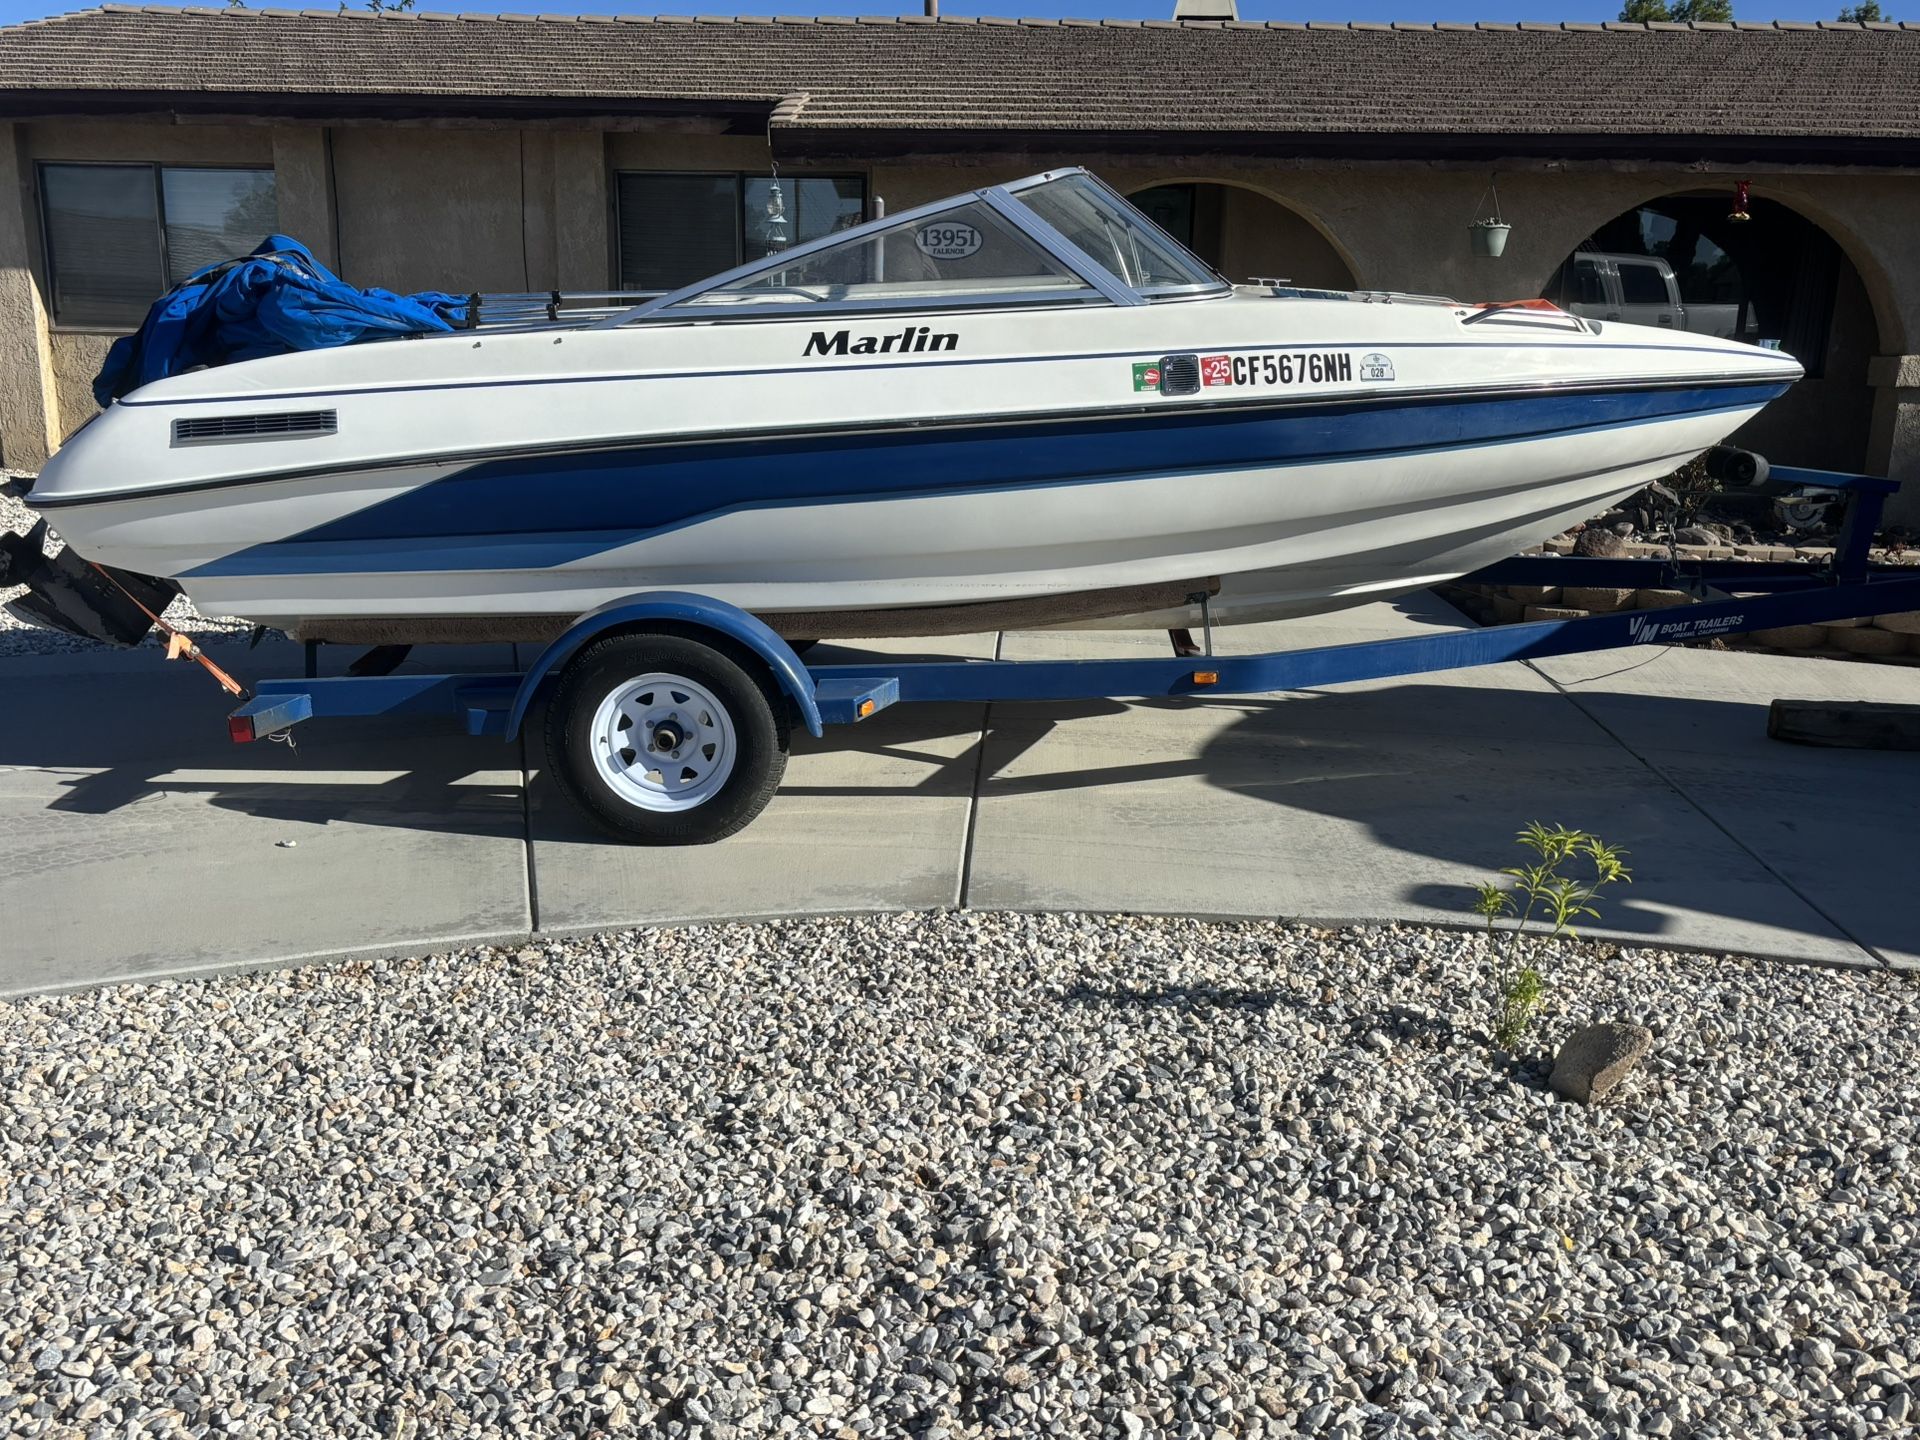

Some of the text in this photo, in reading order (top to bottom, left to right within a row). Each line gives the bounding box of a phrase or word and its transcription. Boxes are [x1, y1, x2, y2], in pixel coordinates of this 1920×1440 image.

[921, 229, 976, 247] 13951
[802, 327, 959, 356] Marlin
[1210, 361, 1230, 378] 25
[1232, 353, 1352, 386] CF5676NH
[1370, 367, 1384, 378] 028
[1660, 621, 1691, 634] BOAT
[1693, 615, 1744, 630] TRAILERS
